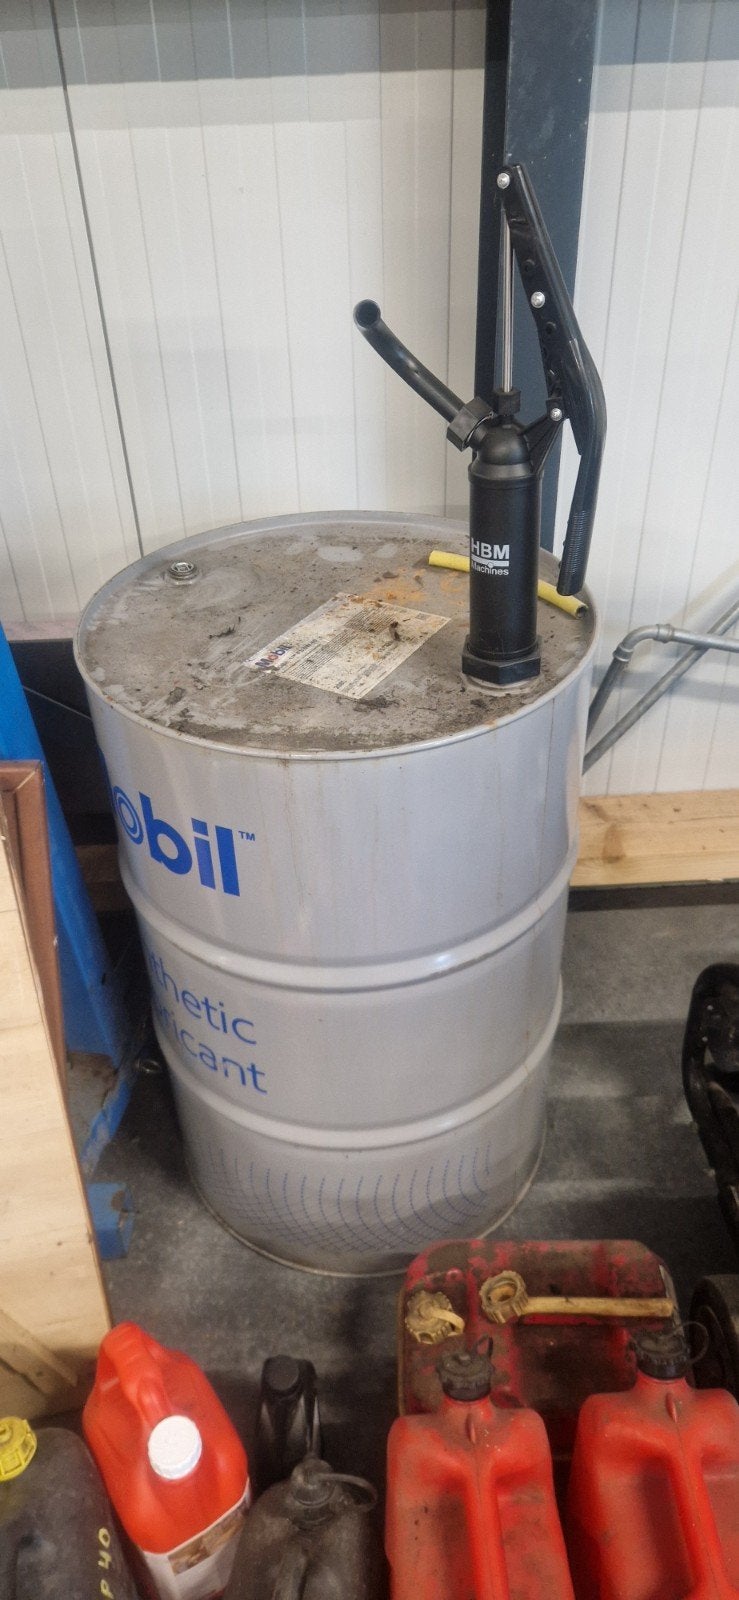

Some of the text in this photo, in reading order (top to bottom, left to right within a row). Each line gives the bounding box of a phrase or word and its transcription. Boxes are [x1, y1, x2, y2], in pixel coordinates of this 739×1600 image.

[471, 538, 510, 560] HBM
[103, 760, 240, 897] obil
[149, 952, 257, 1045] thetic
